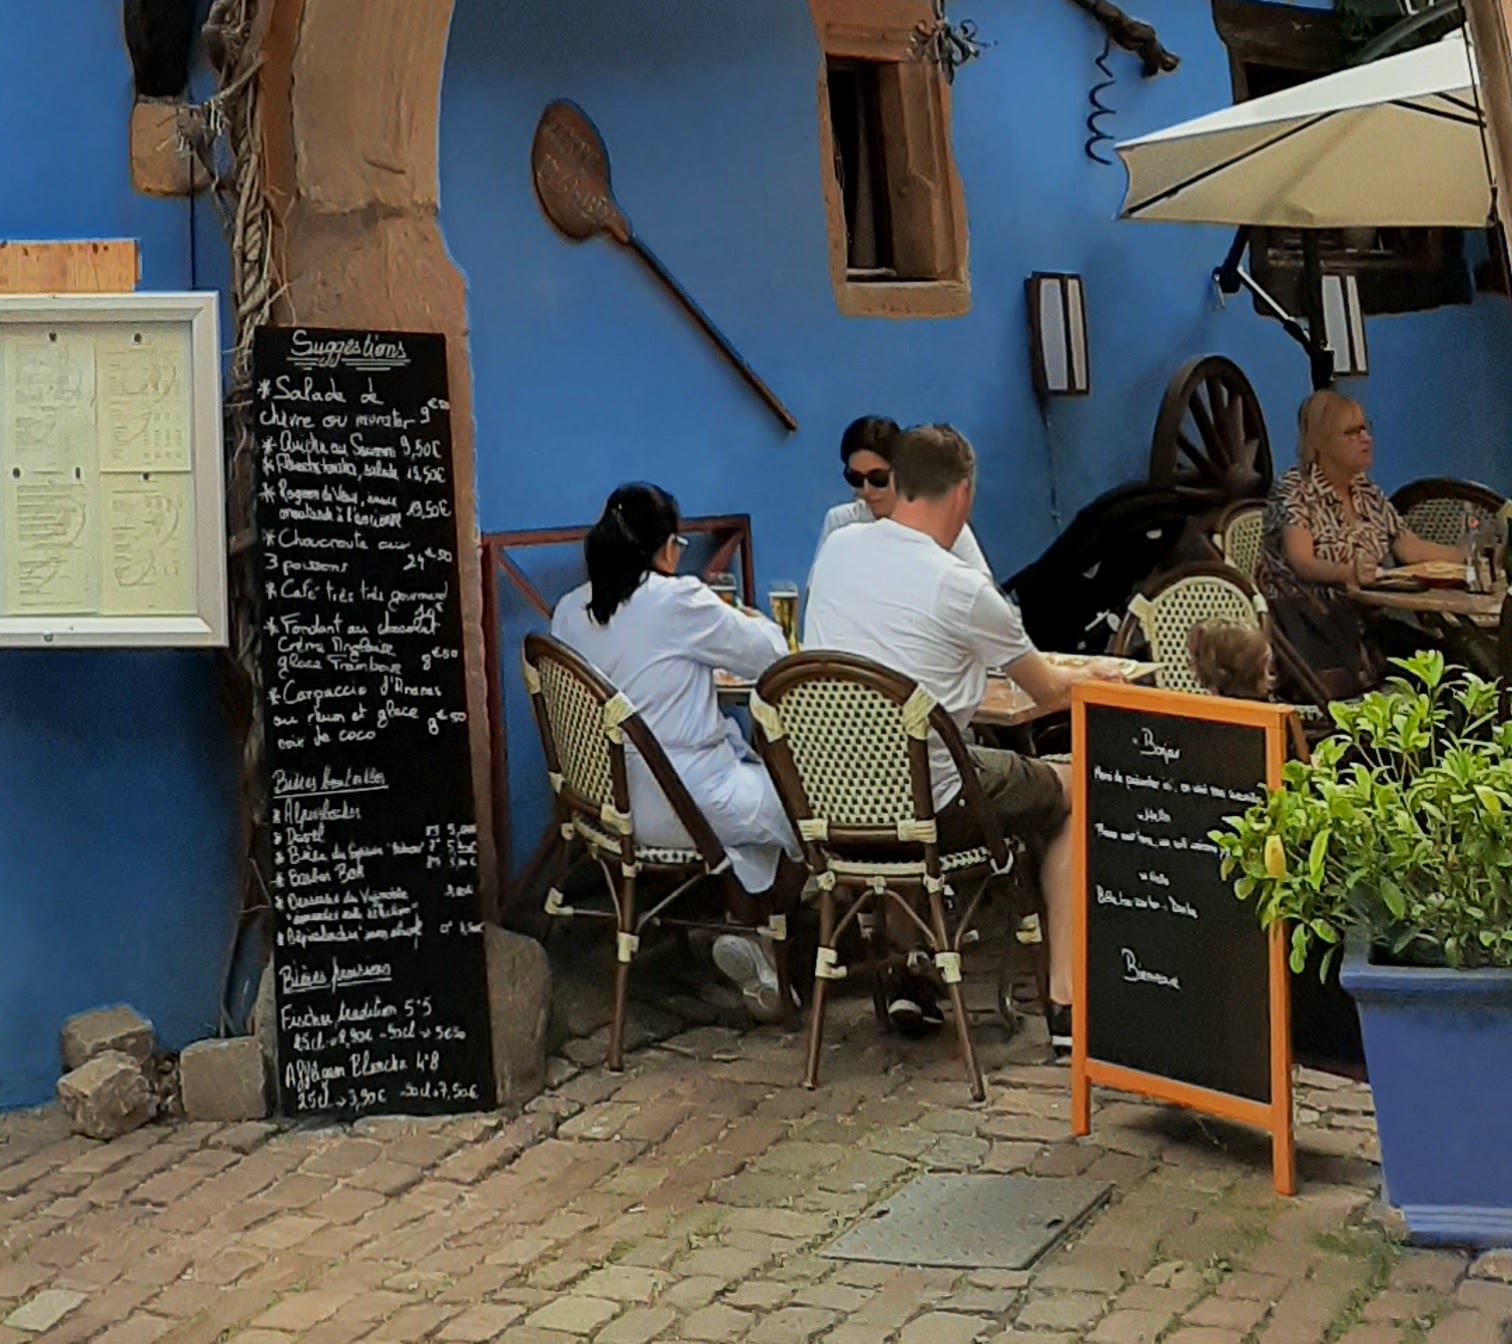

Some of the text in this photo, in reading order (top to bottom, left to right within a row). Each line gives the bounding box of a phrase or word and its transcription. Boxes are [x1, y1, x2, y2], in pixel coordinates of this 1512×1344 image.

[290, 329, 407, 367] Suggestions
[272, 375, 347, 403] Salade
[278, 528, 369, 550] Choucroute
[264, 553, 278, 569] 3
[280, 578, 320, 599] Café
[280, 612, 343, 635] Fondant
[339, 729, 376, 742] coco
